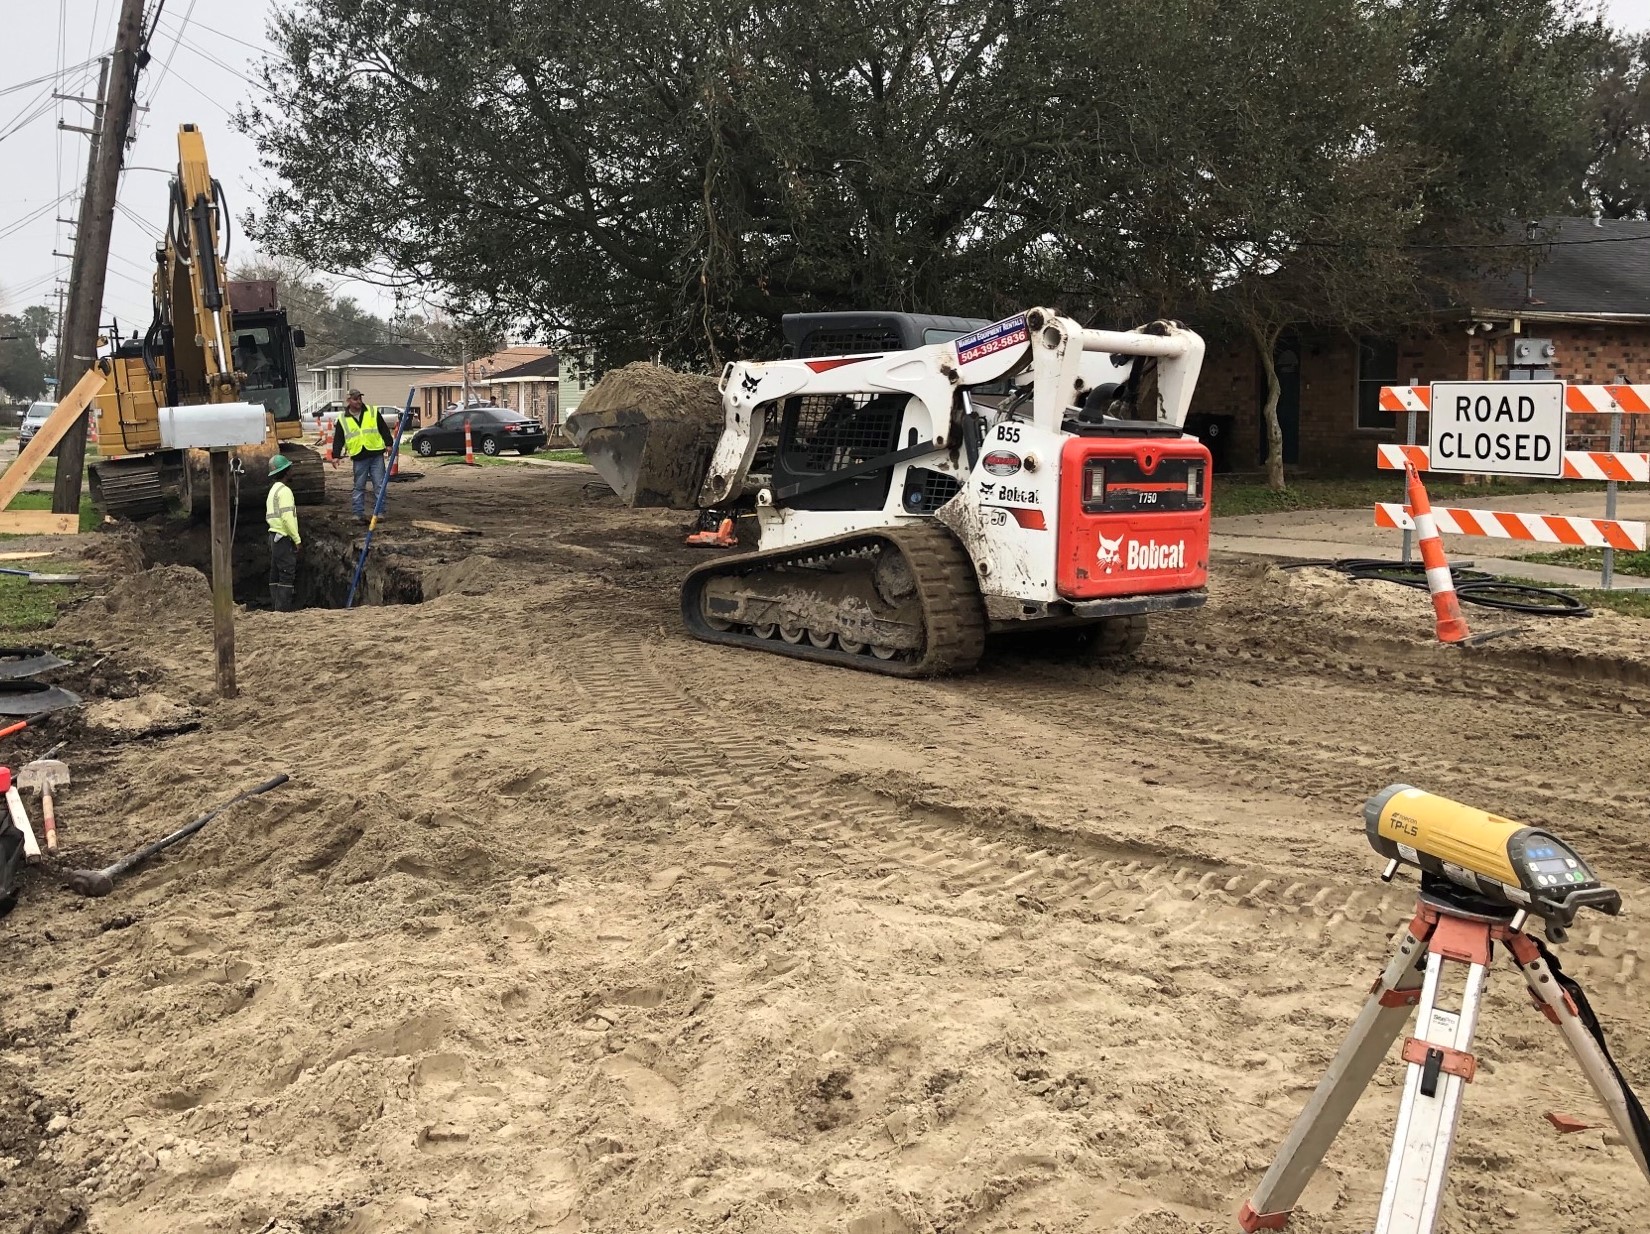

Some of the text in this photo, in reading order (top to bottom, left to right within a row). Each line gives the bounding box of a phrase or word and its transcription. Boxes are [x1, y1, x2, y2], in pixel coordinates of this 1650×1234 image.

[961, 331, 1026, 362] 504-392-5836
[1456, 396, 1535, 422] ROAD
[997, 426, 1020, 443] B55
[1439, 432, 1551, 461] CLOSED
[1139, 493, 1157, 503] T750
[1127, 540, 1185, 570] Bobcat
